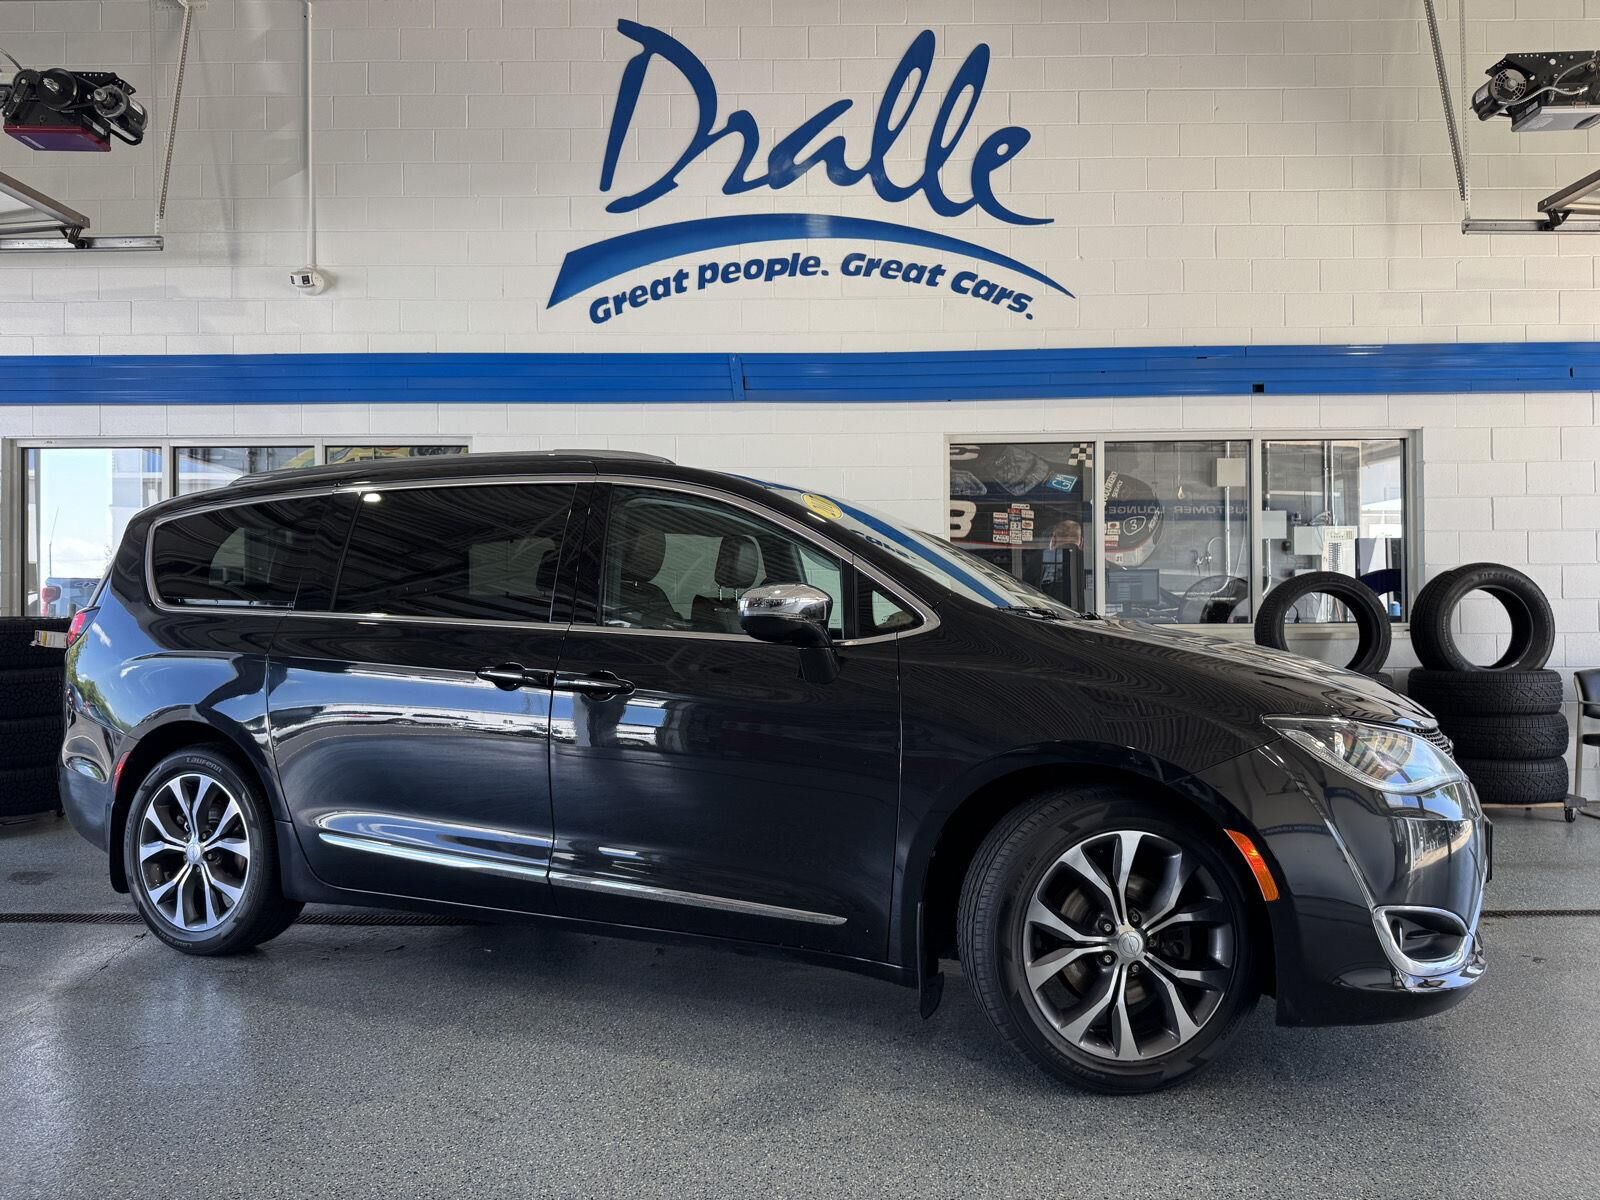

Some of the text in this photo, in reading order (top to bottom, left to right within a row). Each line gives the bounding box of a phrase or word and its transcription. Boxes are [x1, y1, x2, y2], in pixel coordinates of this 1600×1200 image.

[600, 18, 1055, 225] Dralle
[588, 252, 1034, 325] Great people. Great Cars.
[186, 756, 222, 773] Laufenn
